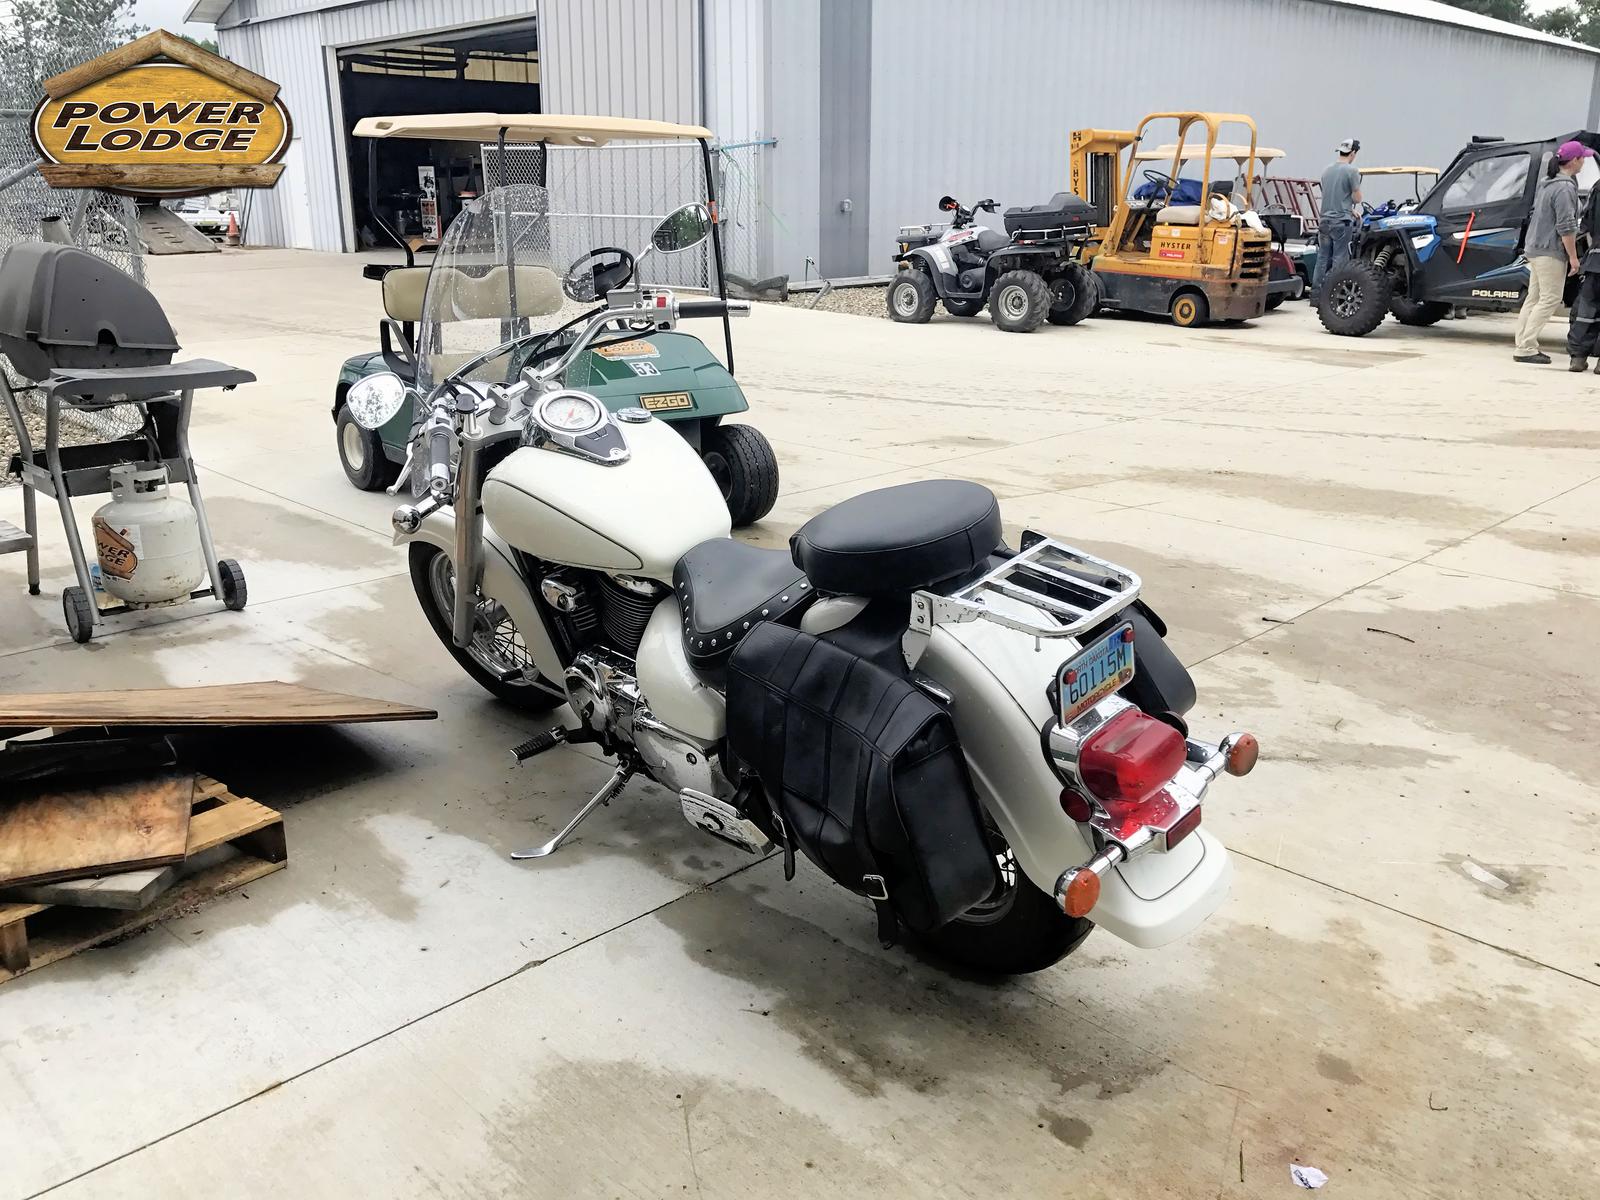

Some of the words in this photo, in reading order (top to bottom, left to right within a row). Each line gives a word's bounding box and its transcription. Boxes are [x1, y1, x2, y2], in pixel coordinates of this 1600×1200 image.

[1160, 242, 1191, 250] HYSTER
[1471, 289, 1519, 298] POLARIS
[633, 363, 657, 376] 53
[645, 395, 688, 408] EZGO
[1089, 648, 1109, 665] DAKOTA
[1069, 644, 1127, 705] 60115M
[1076, 678, 1117, 713] MOTORCYCLE
